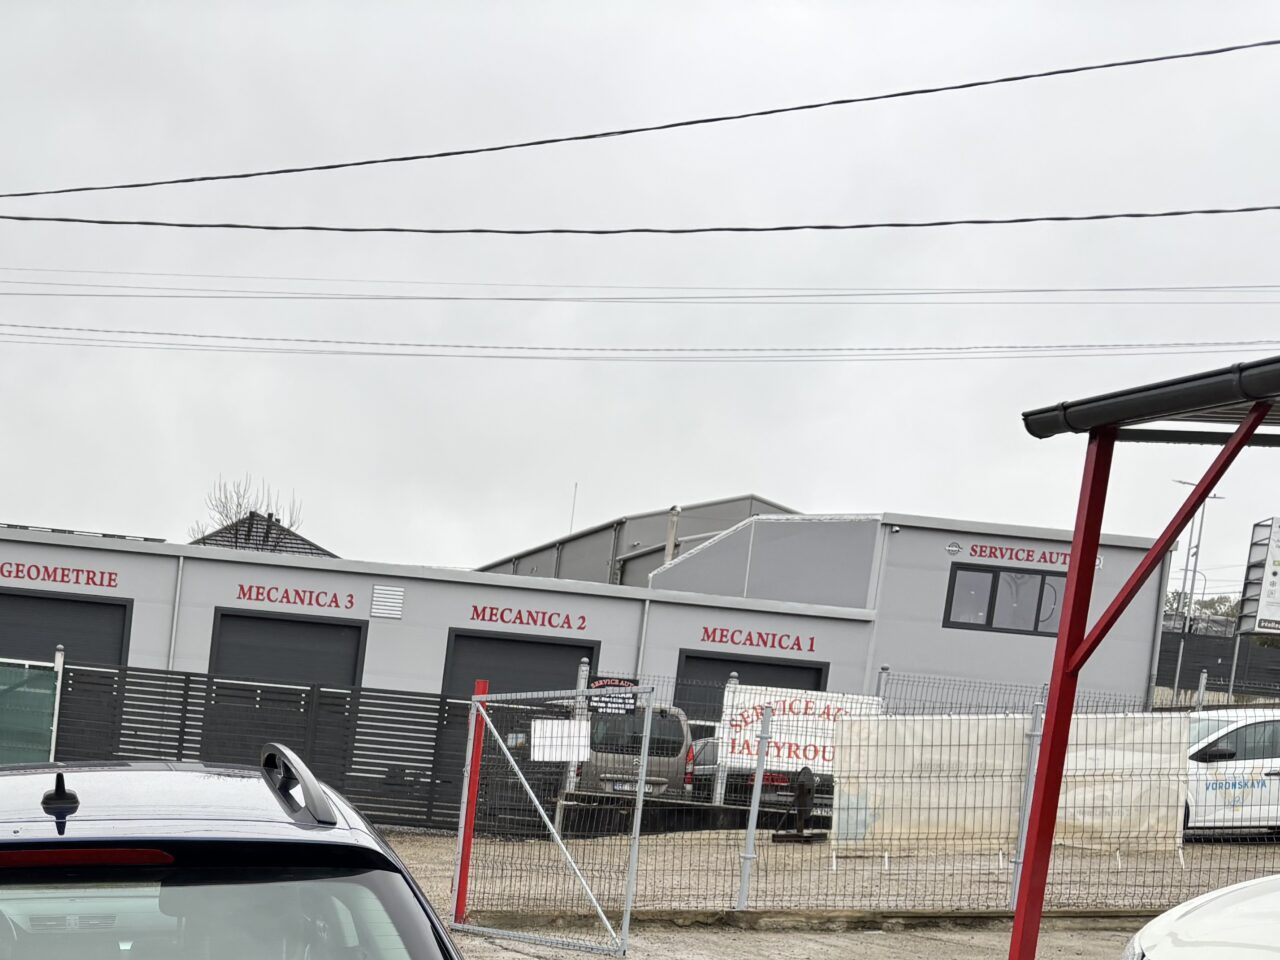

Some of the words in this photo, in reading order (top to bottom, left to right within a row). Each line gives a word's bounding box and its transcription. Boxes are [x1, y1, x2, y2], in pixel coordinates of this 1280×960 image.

[969, 544, 1035, 562] SERVICE
[1037, 551, 1071, 565] AUT
[0, 562, 118, 588] GEOMETRIE
[236, 584, 341, 609] MECANICA
[344, 593, 354, 609] 3
[470, 605, 573, 629] MECANICA
[577, 615, 587, 630] 2
[700, 626, 803, 651] MECANICA
[807, 636, 816, 652] 1
[1206, 780, 1267, 790] VORONSKAYA
